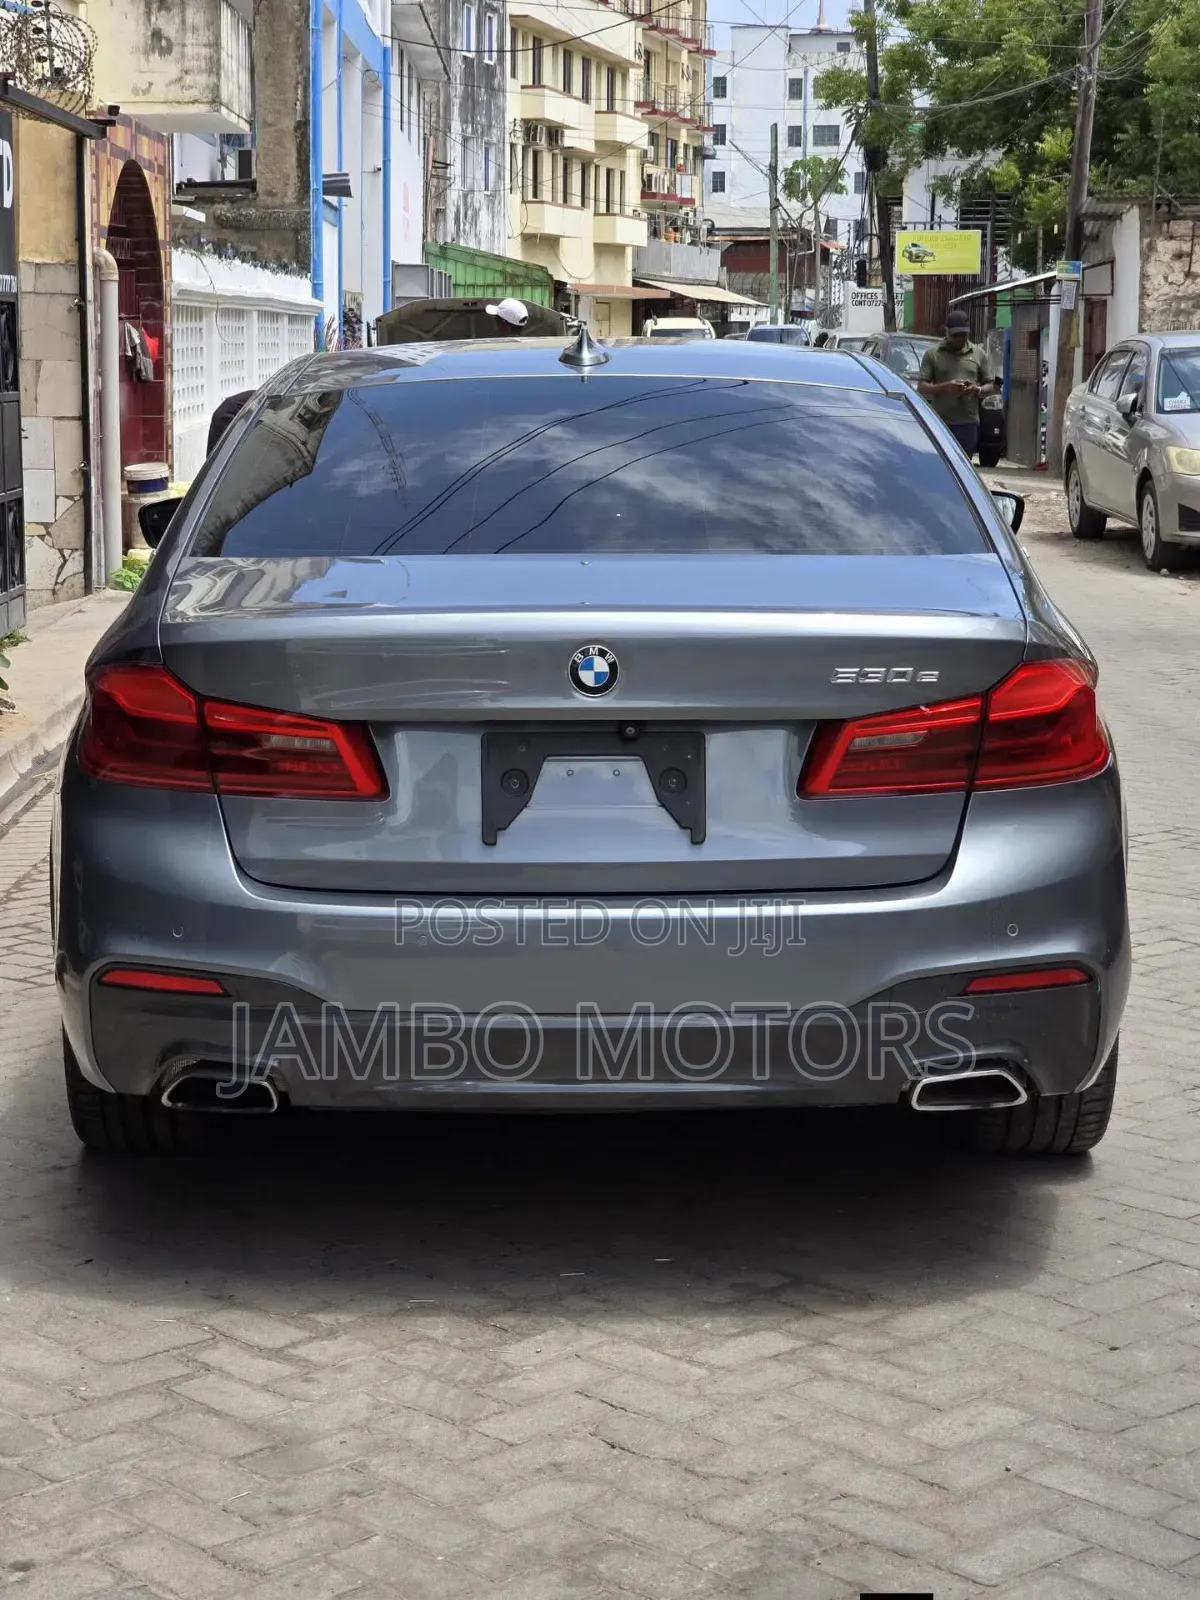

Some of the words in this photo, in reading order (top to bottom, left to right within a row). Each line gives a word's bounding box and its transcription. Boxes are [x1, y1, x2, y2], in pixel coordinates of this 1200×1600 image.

[851, 292, 878, 300] OFFICES
[573, 647, 614, 664] BMW
[830, 667, 940, 684] 530e
